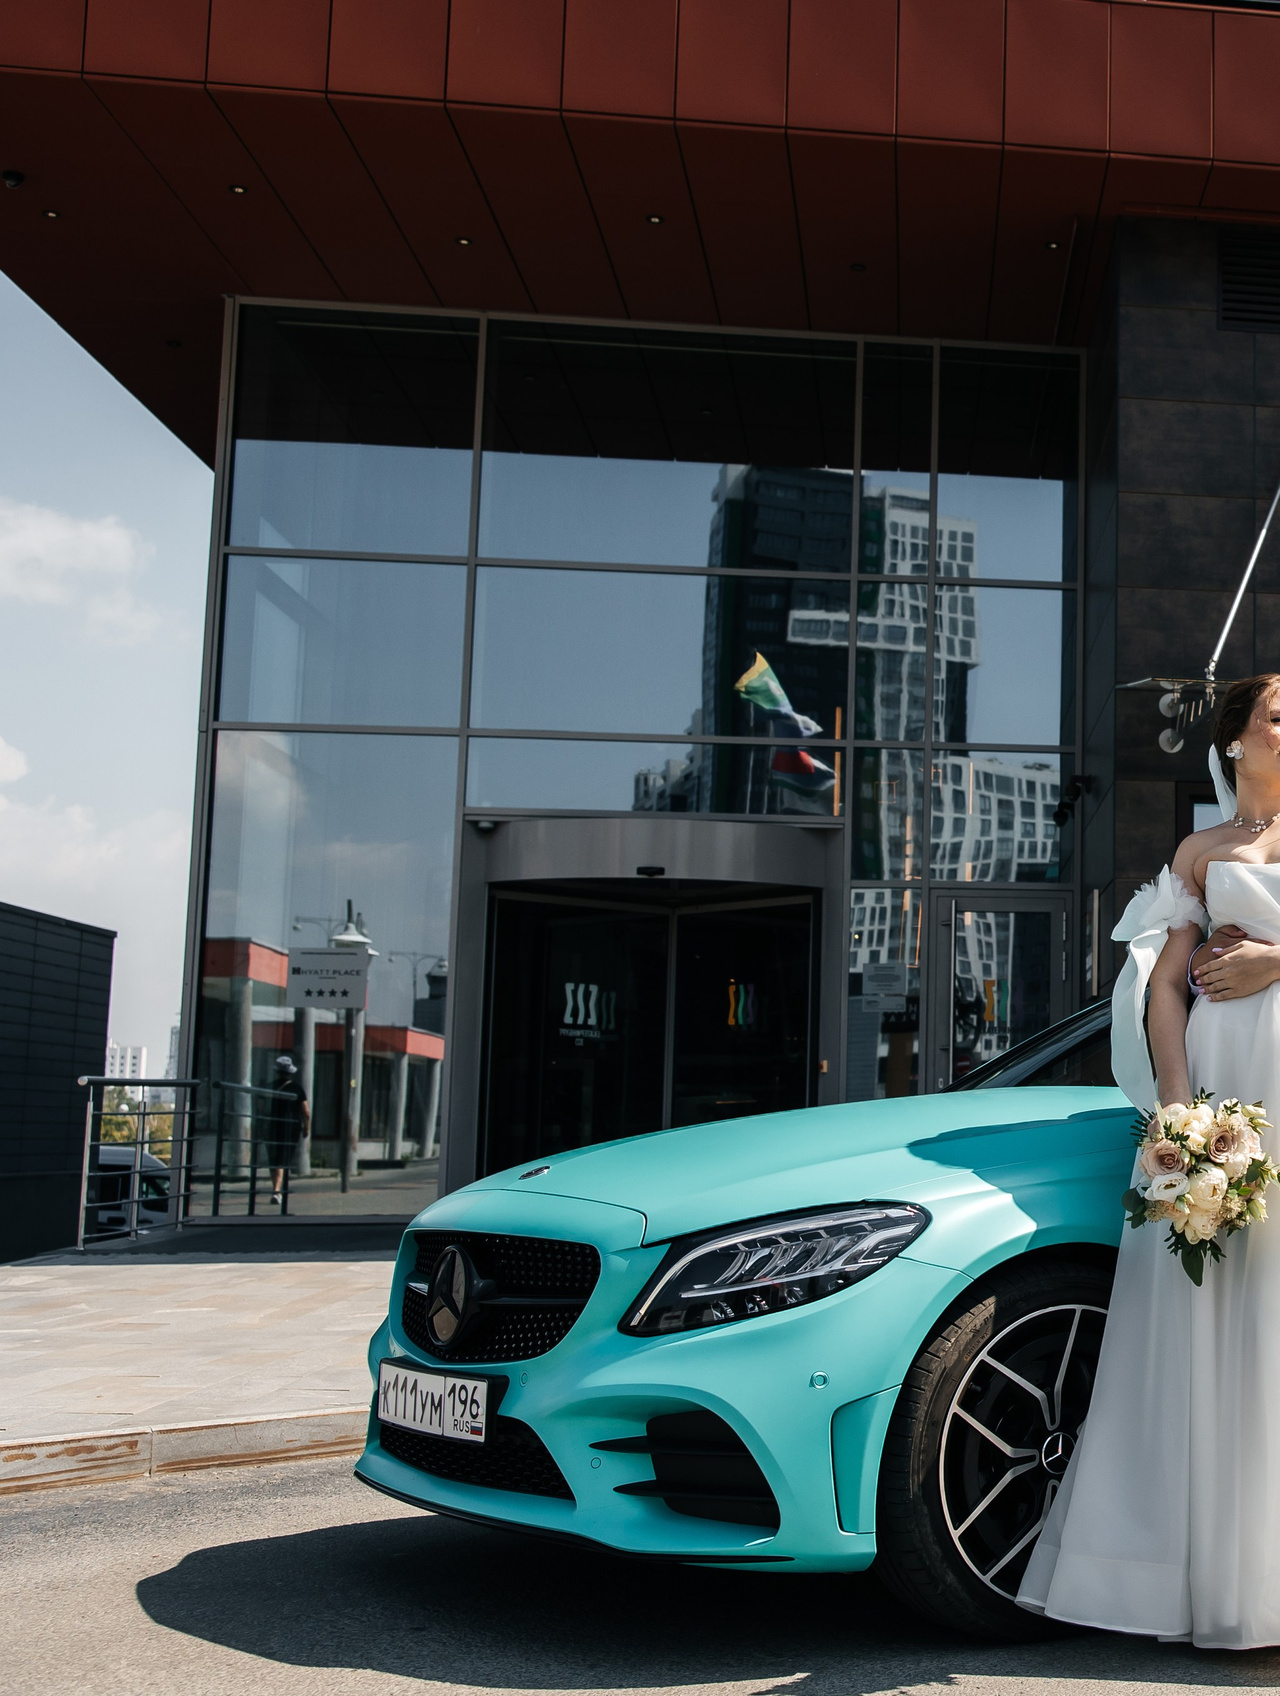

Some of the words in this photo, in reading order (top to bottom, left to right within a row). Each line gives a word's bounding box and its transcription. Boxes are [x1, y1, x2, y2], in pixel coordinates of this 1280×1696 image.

[332, 969, 361, 977] PLACE
[447, 1382, 481, 1420] 196
[452, 1418, 470, 1434] RUS
